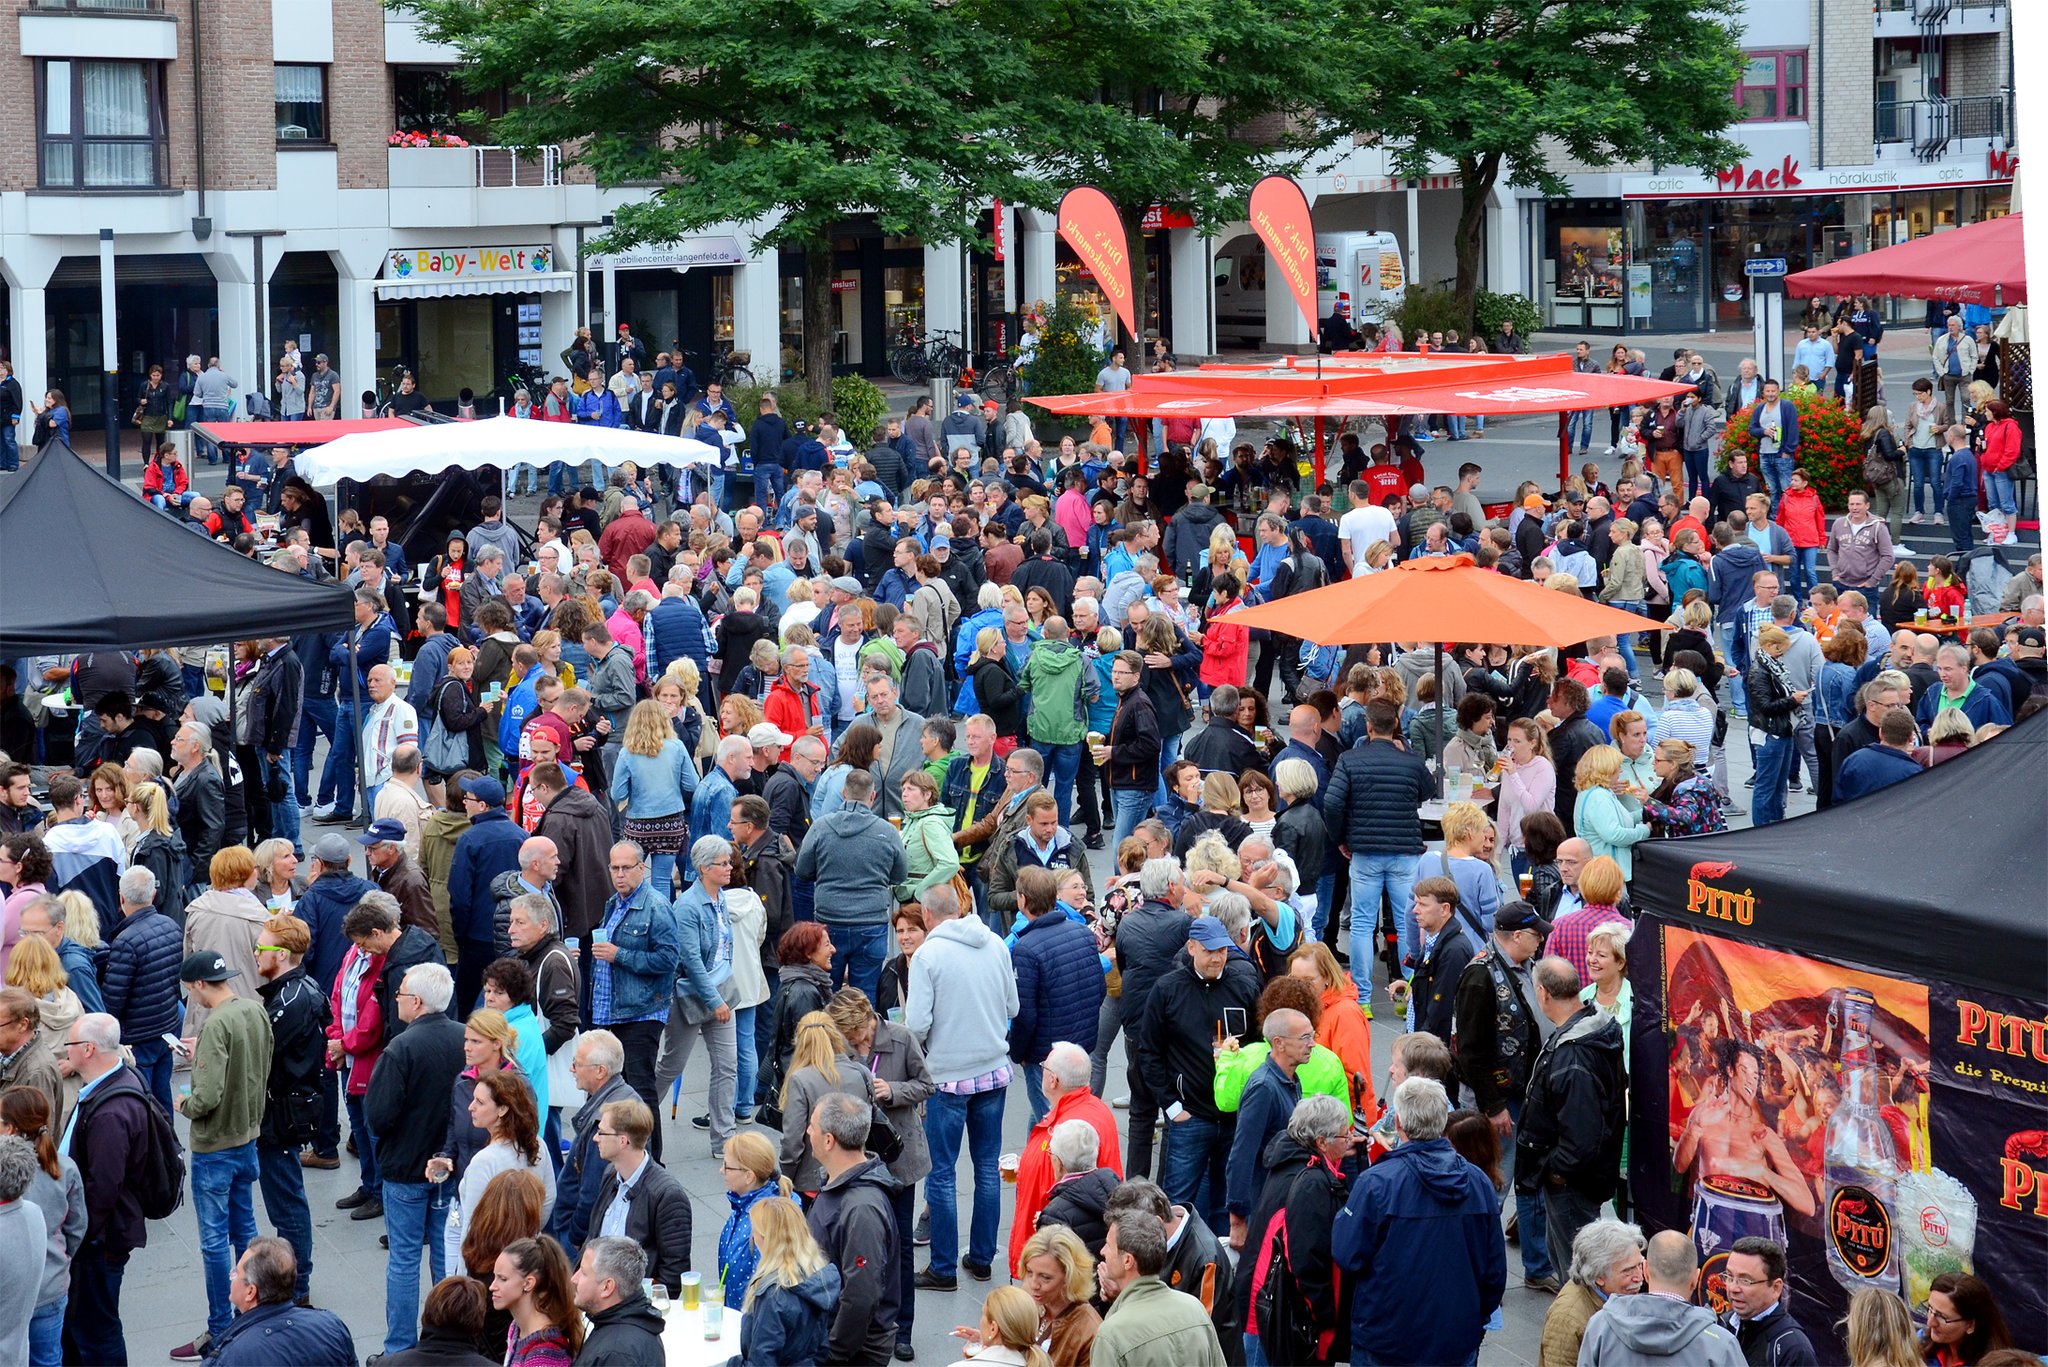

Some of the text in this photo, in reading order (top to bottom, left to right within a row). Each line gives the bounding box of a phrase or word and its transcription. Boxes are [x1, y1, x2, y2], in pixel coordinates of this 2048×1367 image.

[1649, 178, 1684, 192] optic
[1717, 155, 1802, 191] Mack
[1829, 170, 1897, 185] hörakustik
[1939, 167, 1964, 181] optic
[417, 249, 525, 276] Baby-Welt
[1316, 247, 1337, 255] rvice
[1687, 879, 1755, 925] PITÚ
[1954, 1061, 2048, 1093] die Premi
[1836, 1211, 1885, 1248] PITÚ
